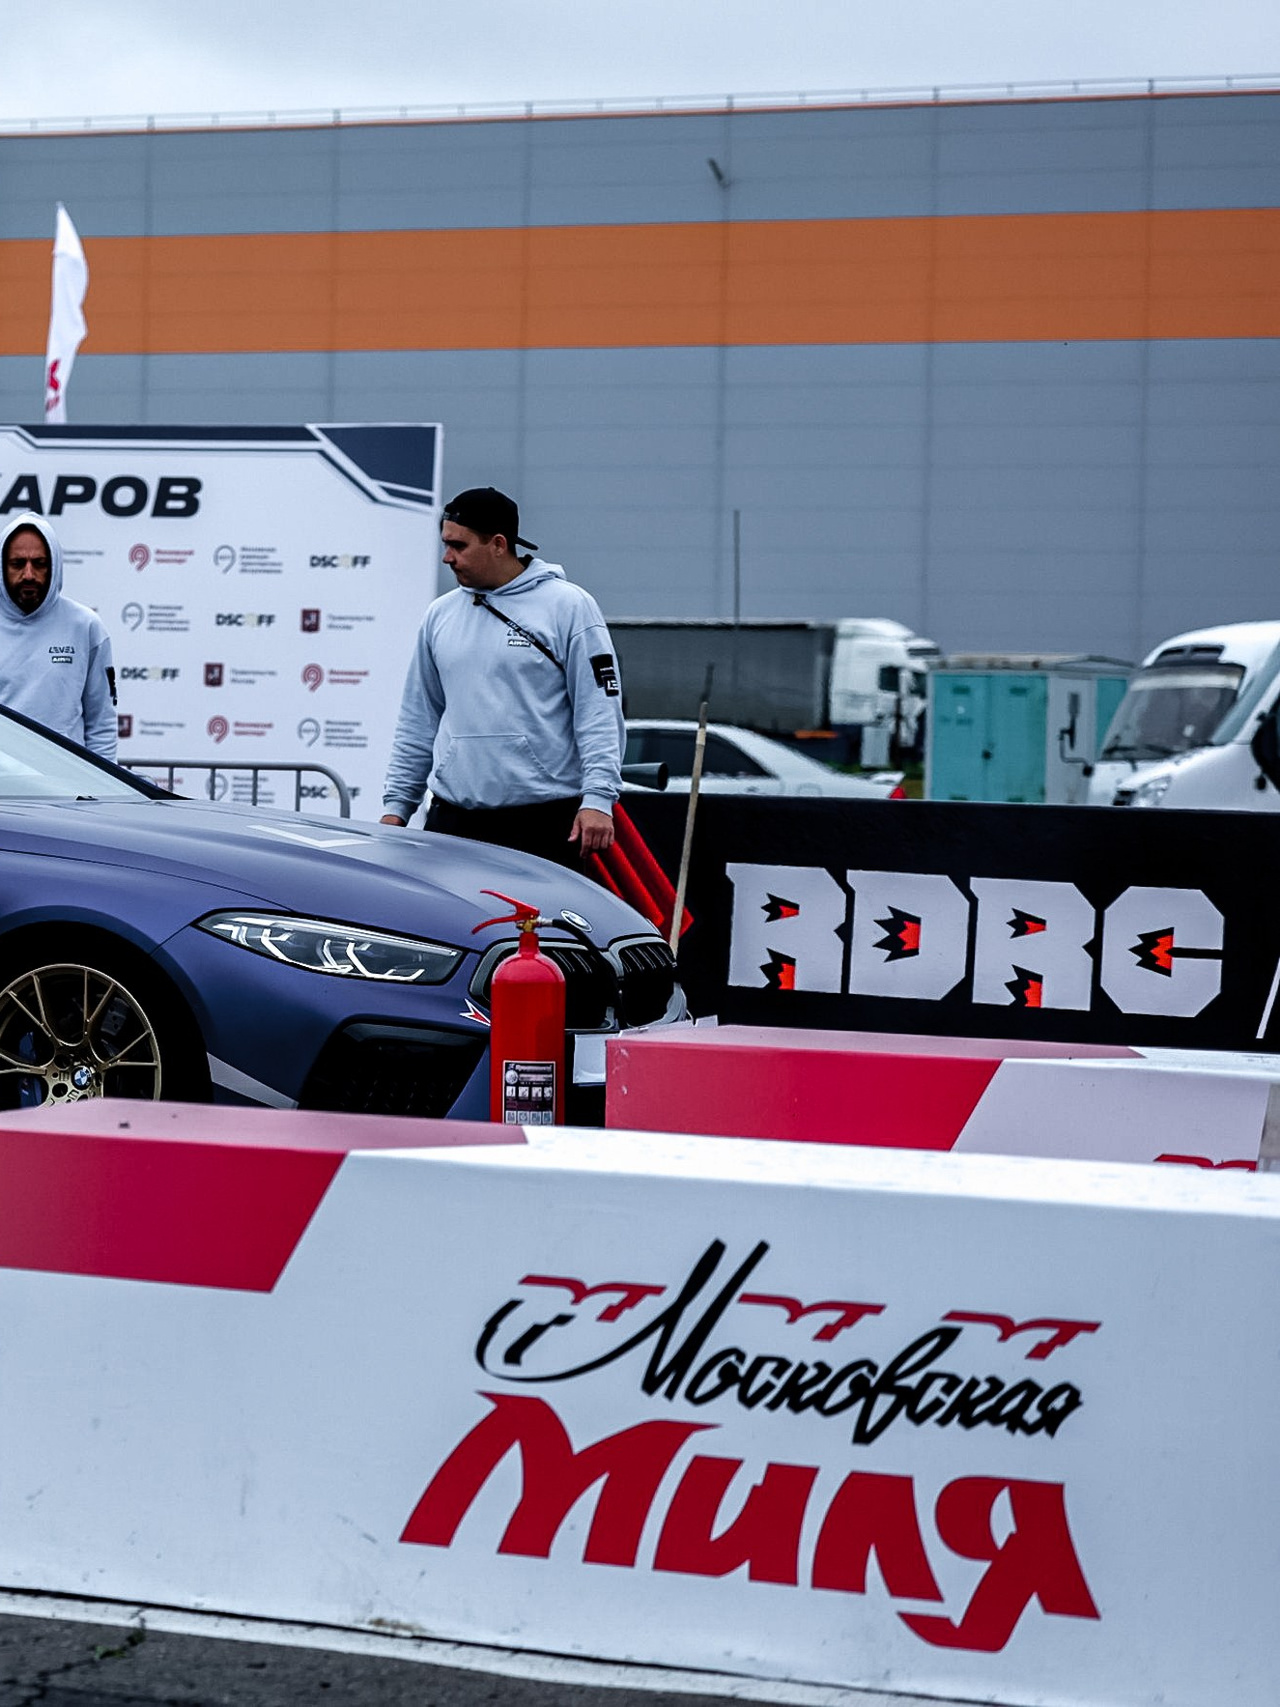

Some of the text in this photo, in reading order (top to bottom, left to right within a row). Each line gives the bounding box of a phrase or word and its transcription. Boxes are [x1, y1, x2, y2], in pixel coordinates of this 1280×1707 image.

[725, 862, 1225, 1018] RDRC
[474, 1237, 1084, 1446] Московская
[398, 1390, 1102, 1653] Миля
